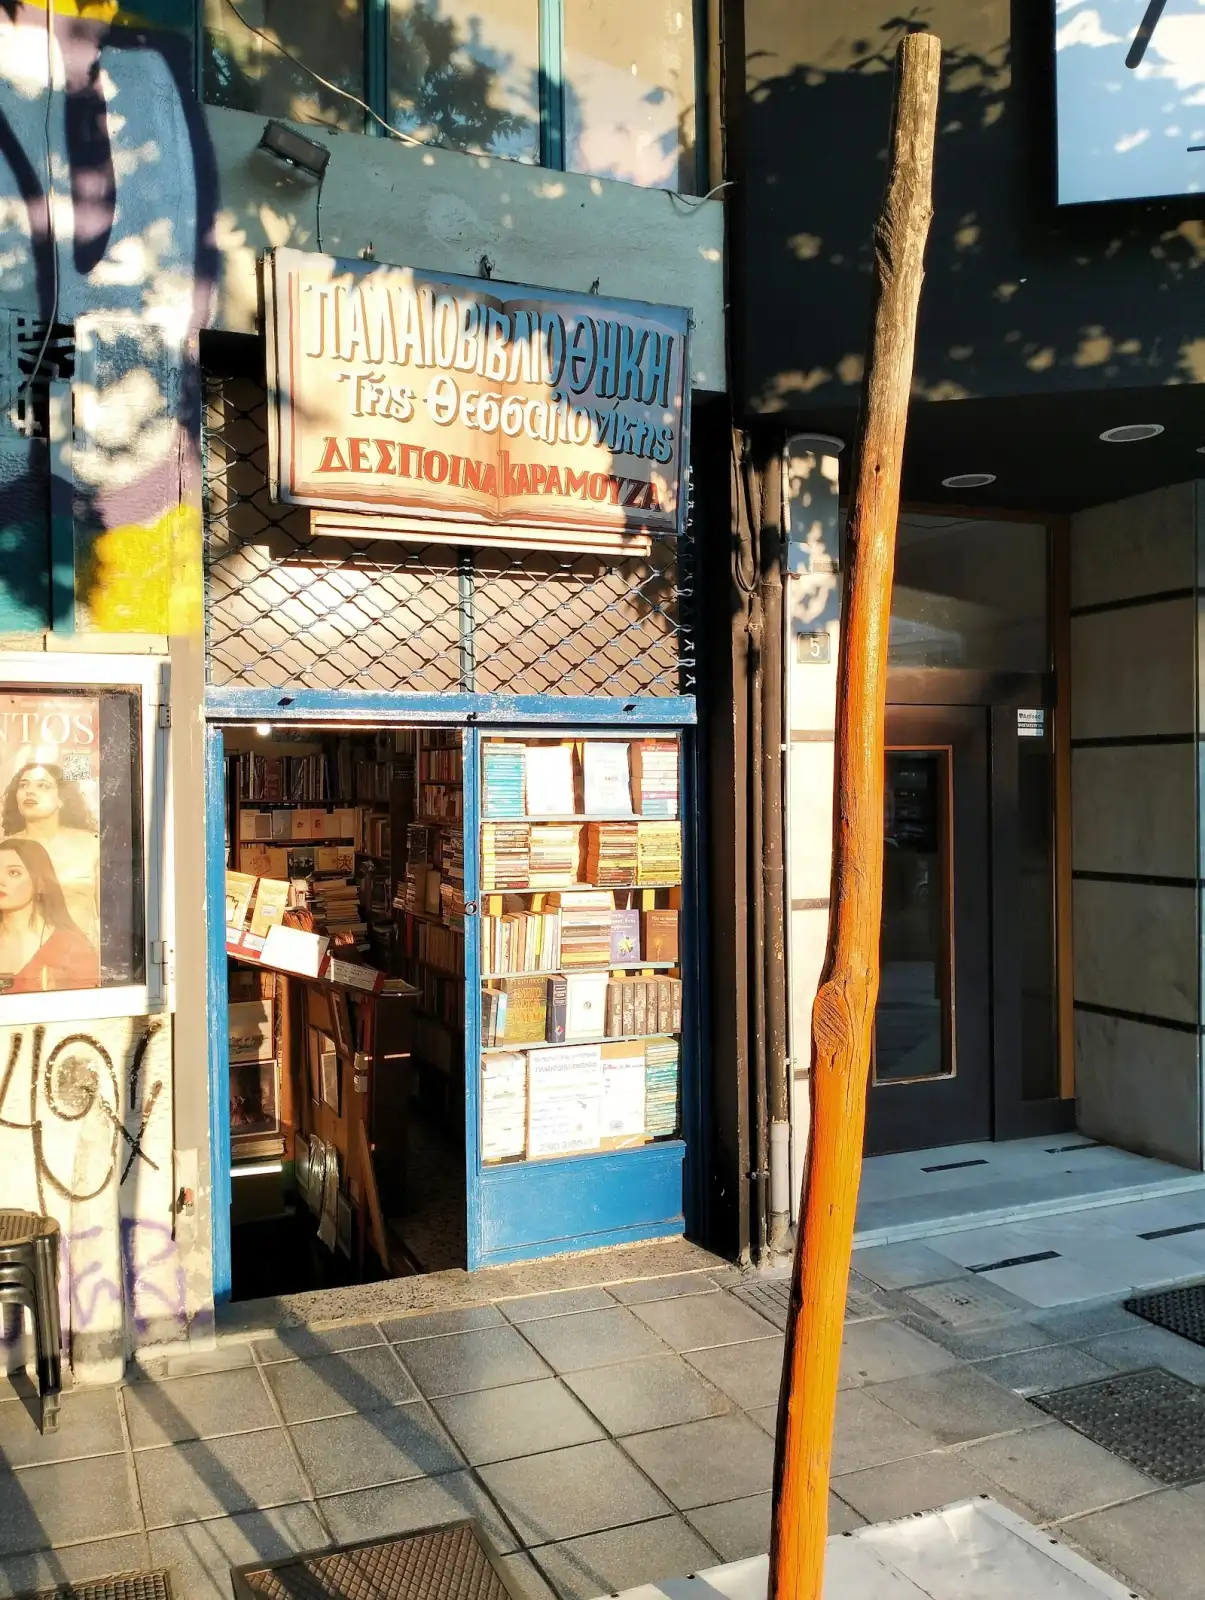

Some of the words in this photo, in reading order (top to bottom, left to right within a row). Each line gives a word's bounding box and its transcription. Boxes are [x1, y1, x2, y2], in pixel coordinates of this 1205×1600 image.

[300, 282, 674, 408] ΠΑΛΑΙΟΒΙΒΛΙΟΘΗΚΗ
[312, 436, 499, 498] ΔΕΣΠΟΙΝΑ
[497, 450, 661, 512] ΚΑΡΑΜΟΥΖΑ
[809, 637, 821, 658] 5
